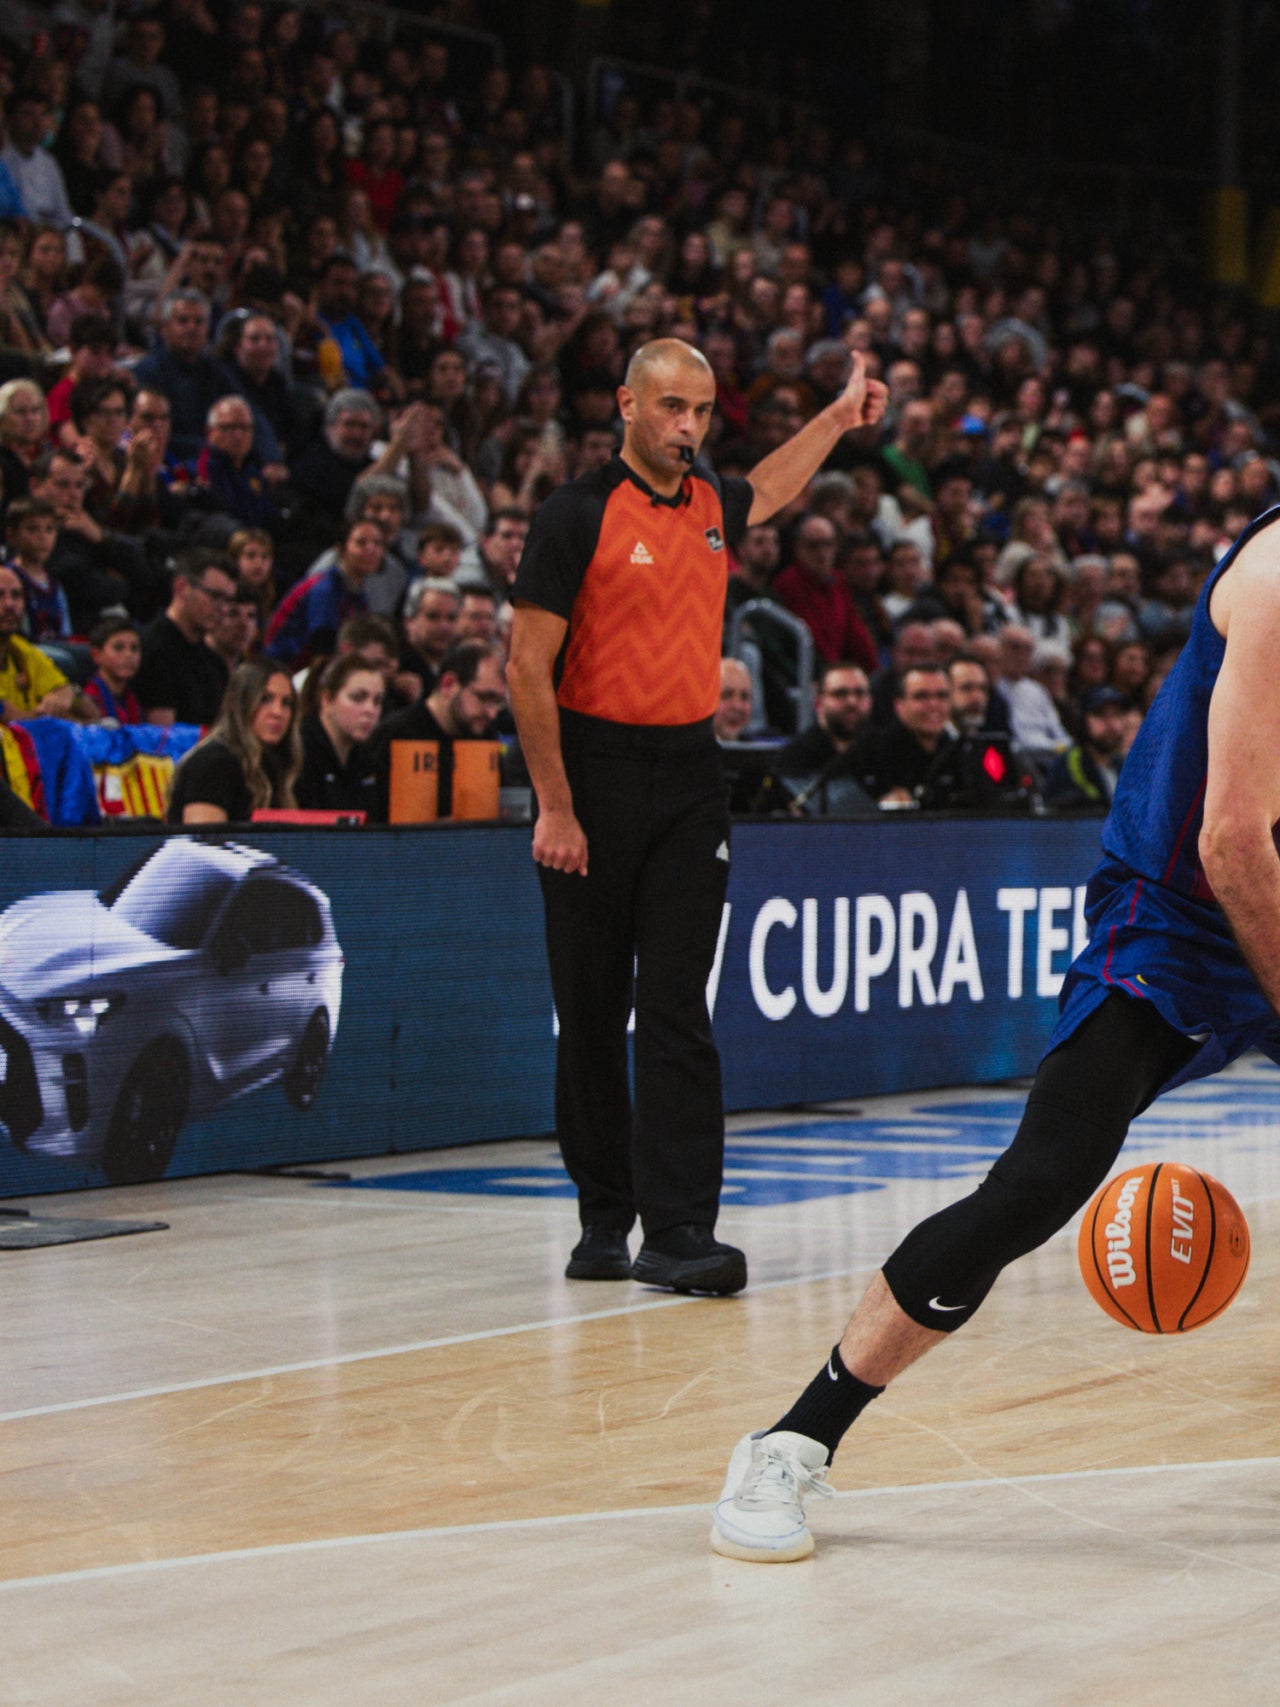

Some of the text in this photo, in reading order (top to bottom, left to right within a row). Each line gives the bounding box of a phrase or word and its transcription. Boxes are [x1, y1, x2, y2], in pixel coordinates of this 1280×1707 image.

[749, 887, 984, 1021] CUPRA
[1105, 1176, 1144, 1290] Wilson
[1170, 1195, 1194, 1264] EVO
